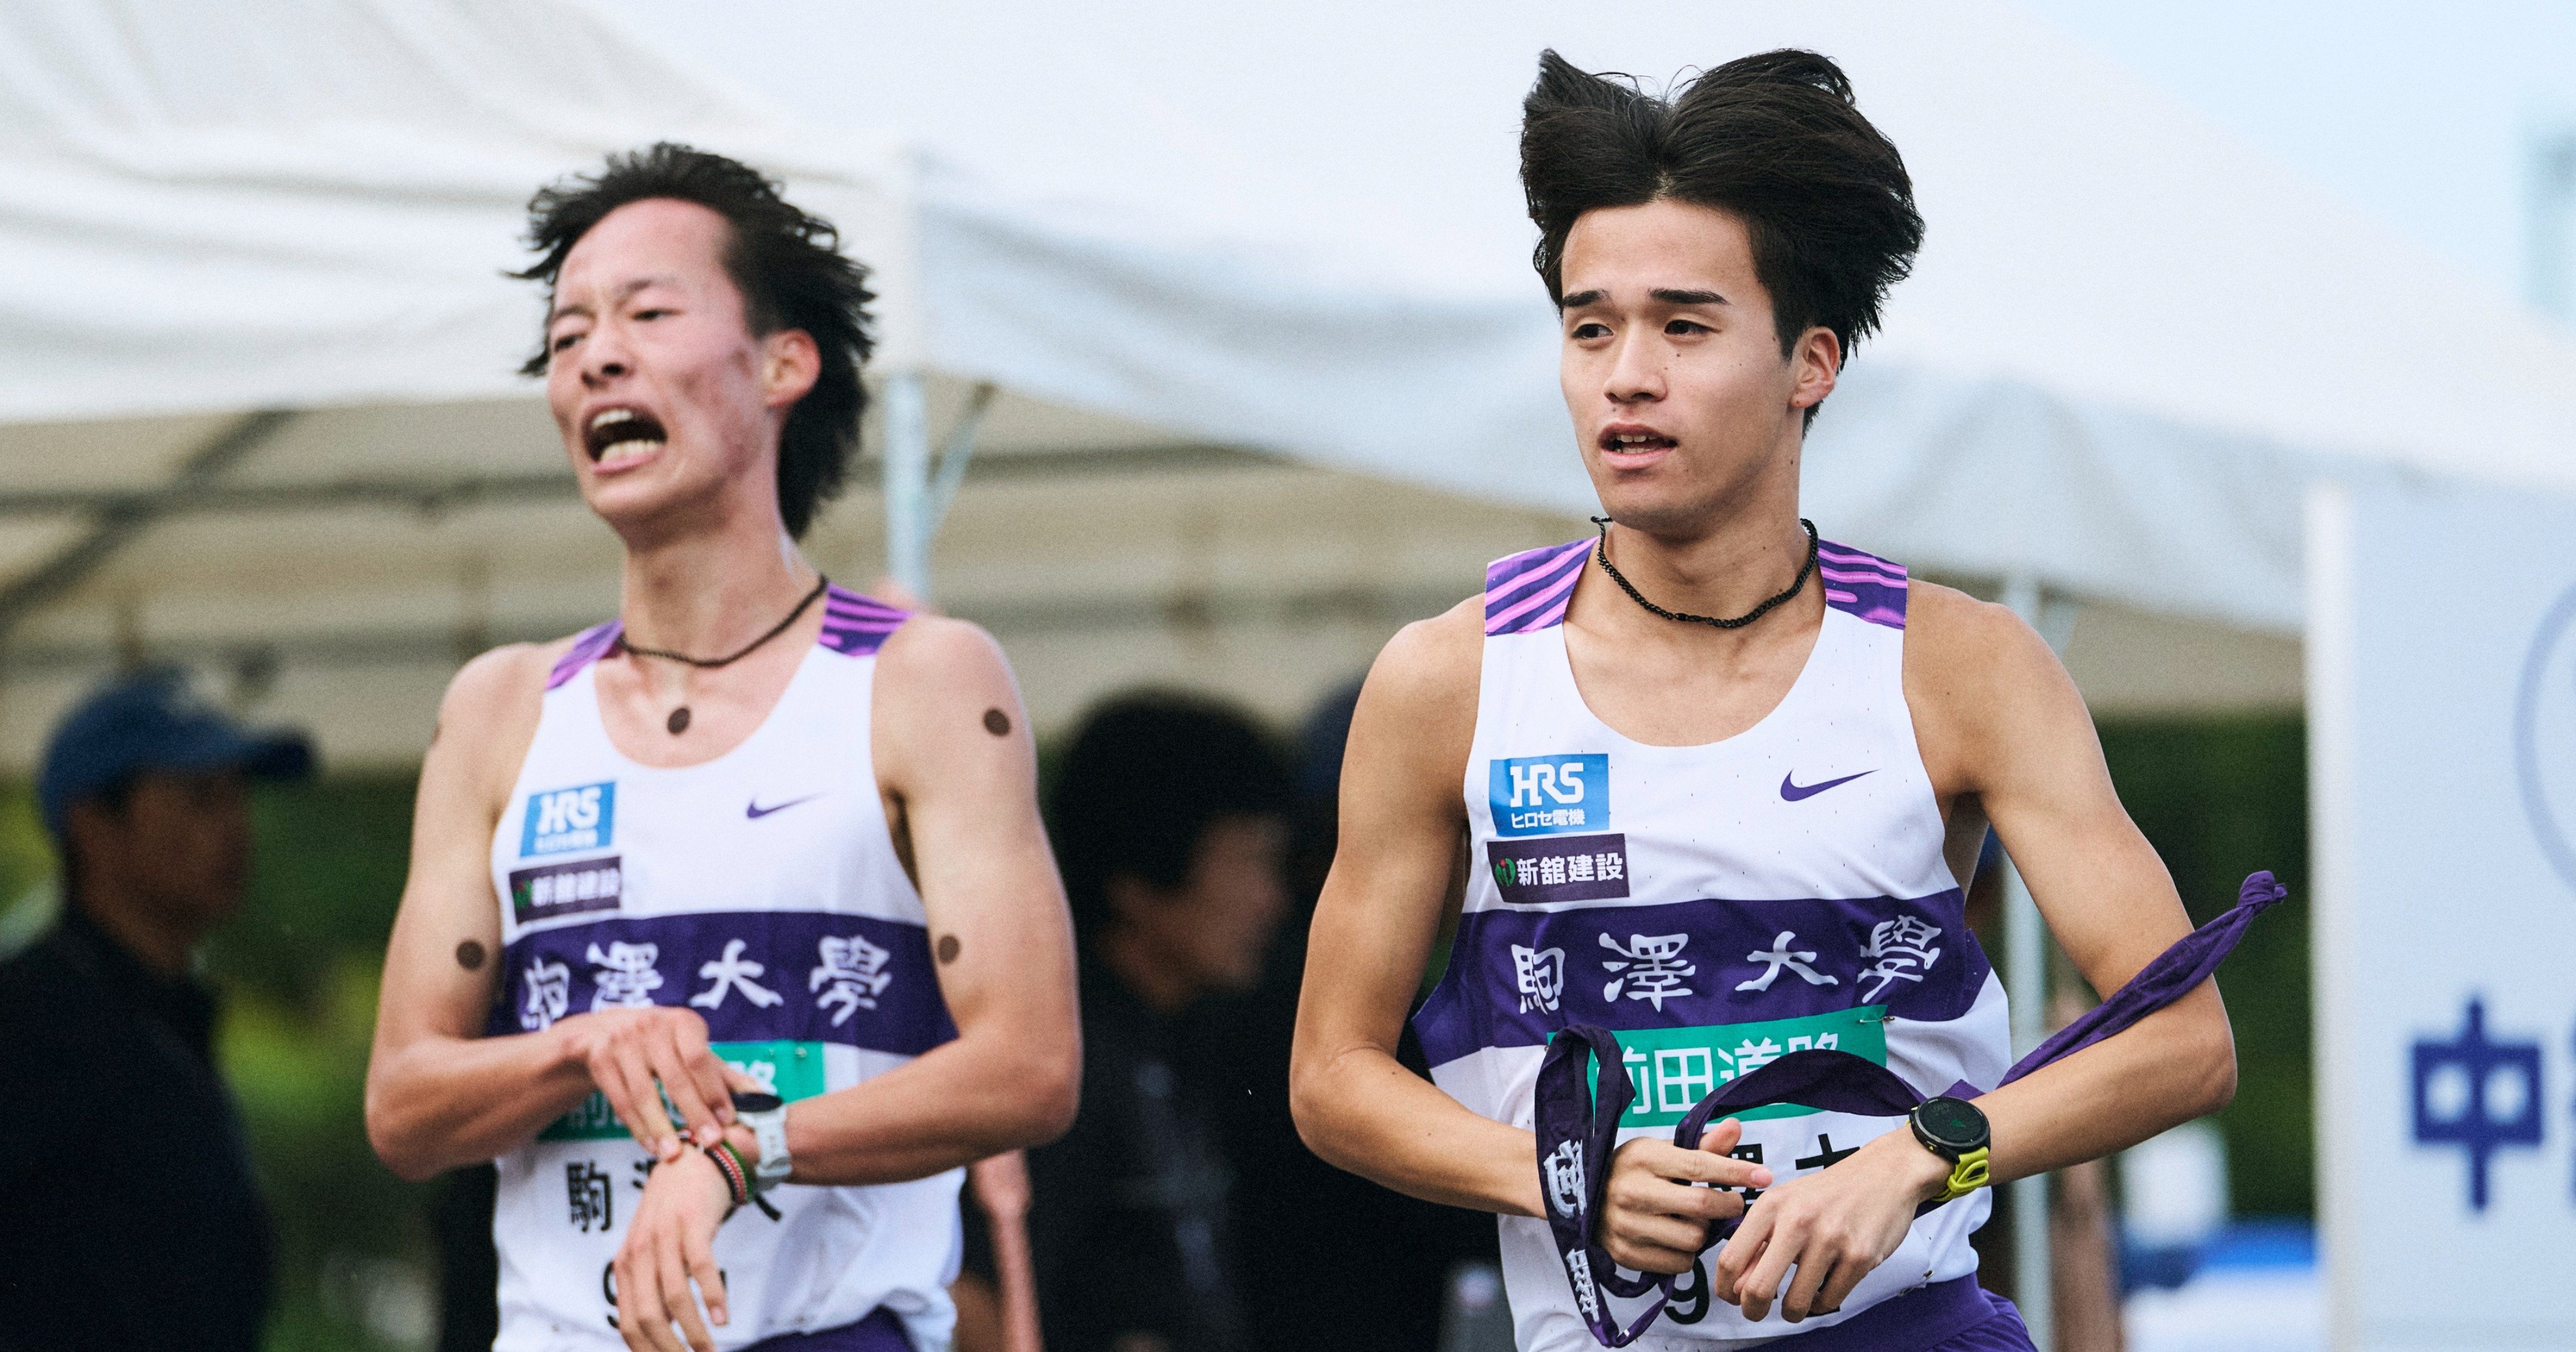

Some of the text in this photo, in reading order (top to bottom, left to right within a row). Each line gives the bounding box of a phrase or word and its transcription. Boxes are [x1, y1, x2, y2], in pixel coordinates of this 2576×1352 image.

[1510, 763, 1584, 807] HRS
[536, 786, 602, 835] HRS
[1511, 808, 1585, 829] ヒロセ電機
[1516, 852, 1624, 886] 新舘建設
[1510, 913, 1942, 1015] 駒澤大學
[2409, 996, 2576, 1211] 中
